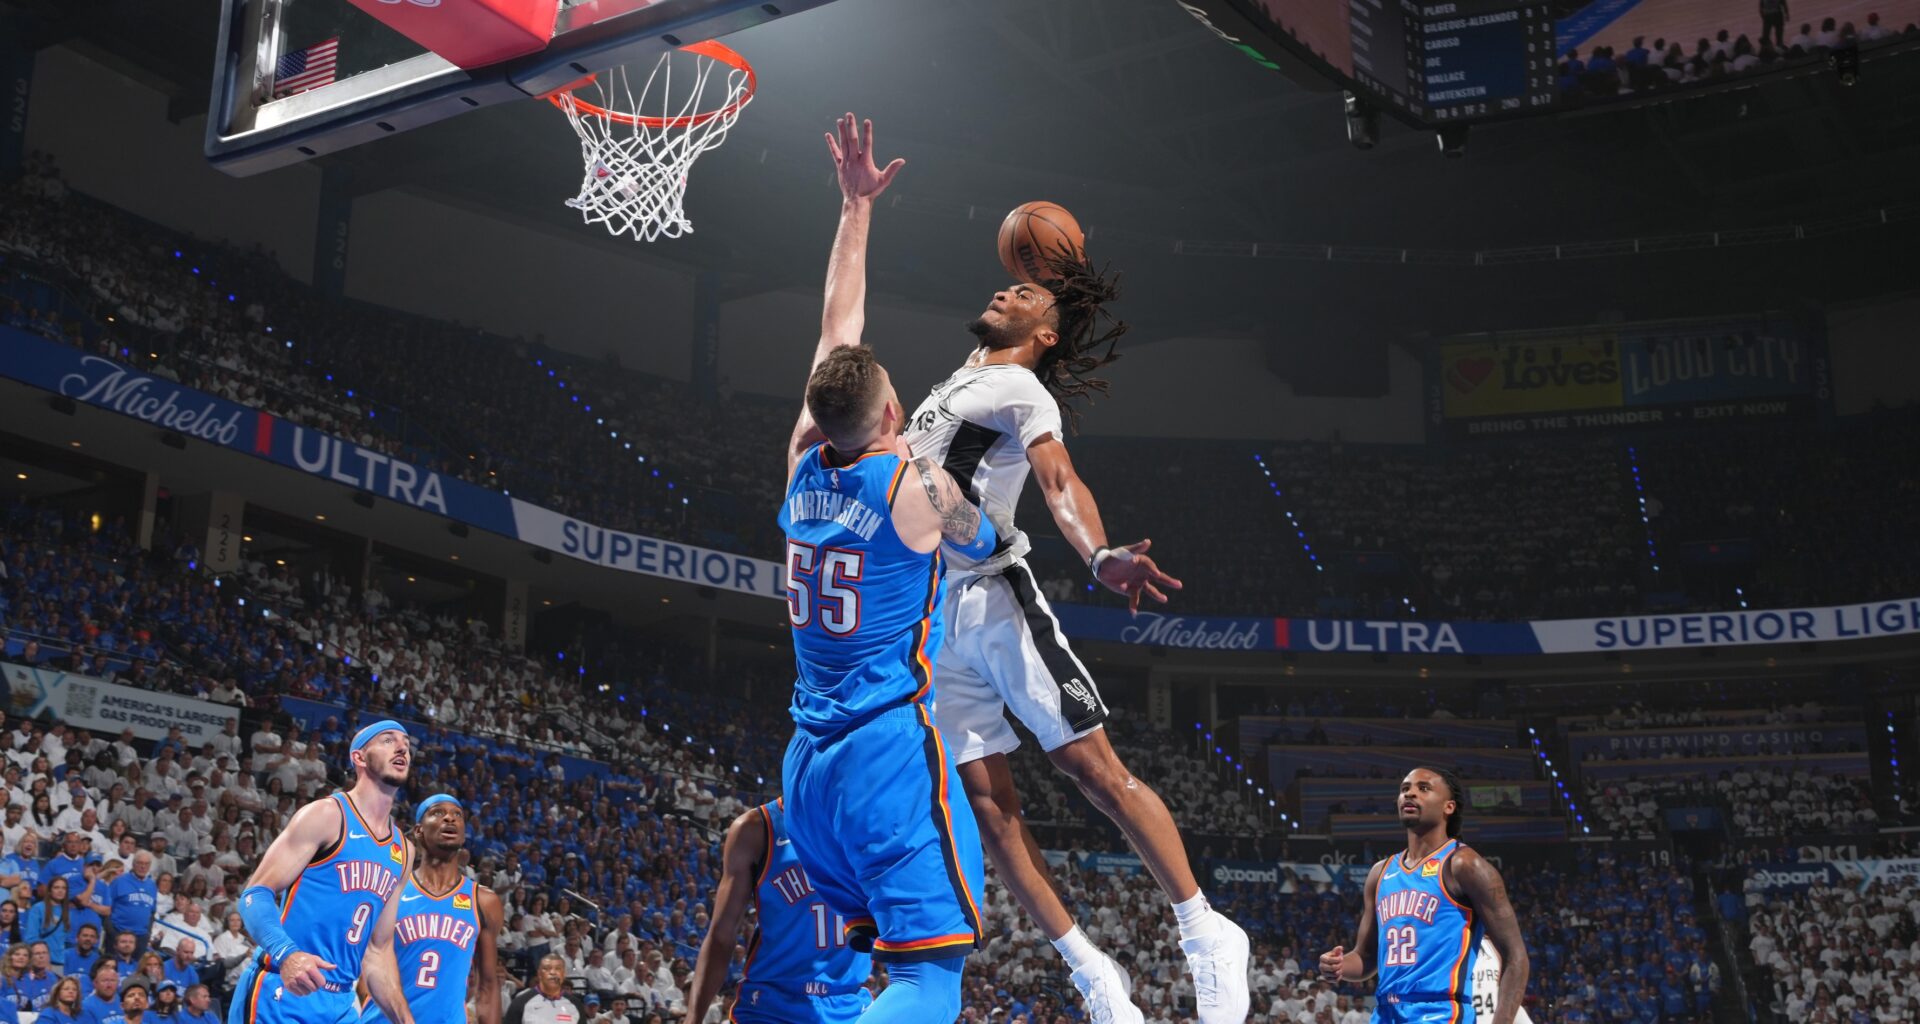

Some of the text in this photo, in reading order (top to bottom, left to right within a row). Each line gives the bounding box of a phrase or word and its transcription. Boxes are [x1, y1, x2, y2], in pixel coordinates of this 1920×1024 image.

[1423, 3, 1456, 16] PLAYER
[1423, 10, 1519, 33] GILGEOUS-ALEXANDER
[1424, 36, 1460, 51] CARUSO
[1425, 56, 1441, 68] JOE
[1426, 70, 1466, 84] WALLACE
[1427, 86, 1487, 102] HARTENSTEIN
[60, 356, 241, 445] Michelob
[1468, 401, 1787, 435] BRING THE THUNDER EXIT NOW
[292, 428, 447, 514] ULTRA
[217, 513, 230, 562] 225
[562, 520, 756, 591] SUPERIOR
[786, 538, 864, 637] 55
[1121, 612, 1463, 653] Michelob ULTRA
[1595, 611, 1816, 648] SUPERIOR
[100, 708, 127, 722] GAS
[101, 694, 226, 728] AMERICA'S LARGES
[1609, 731, 1824, 750] RIVERWIND CASINO
[337, 861, 399, 905] THUNDE
[1213, 864, 1278, 885] expand
[347, 902, 372, 943] 9
[1377, 889, 1440, 926] THUNDER
[395, 914, 475, 949] THUNDER
[1386, 926, 1417, 967] 22
[416, 951, 440, 989] 2
[1472, 993, 1494, 1015] 24
